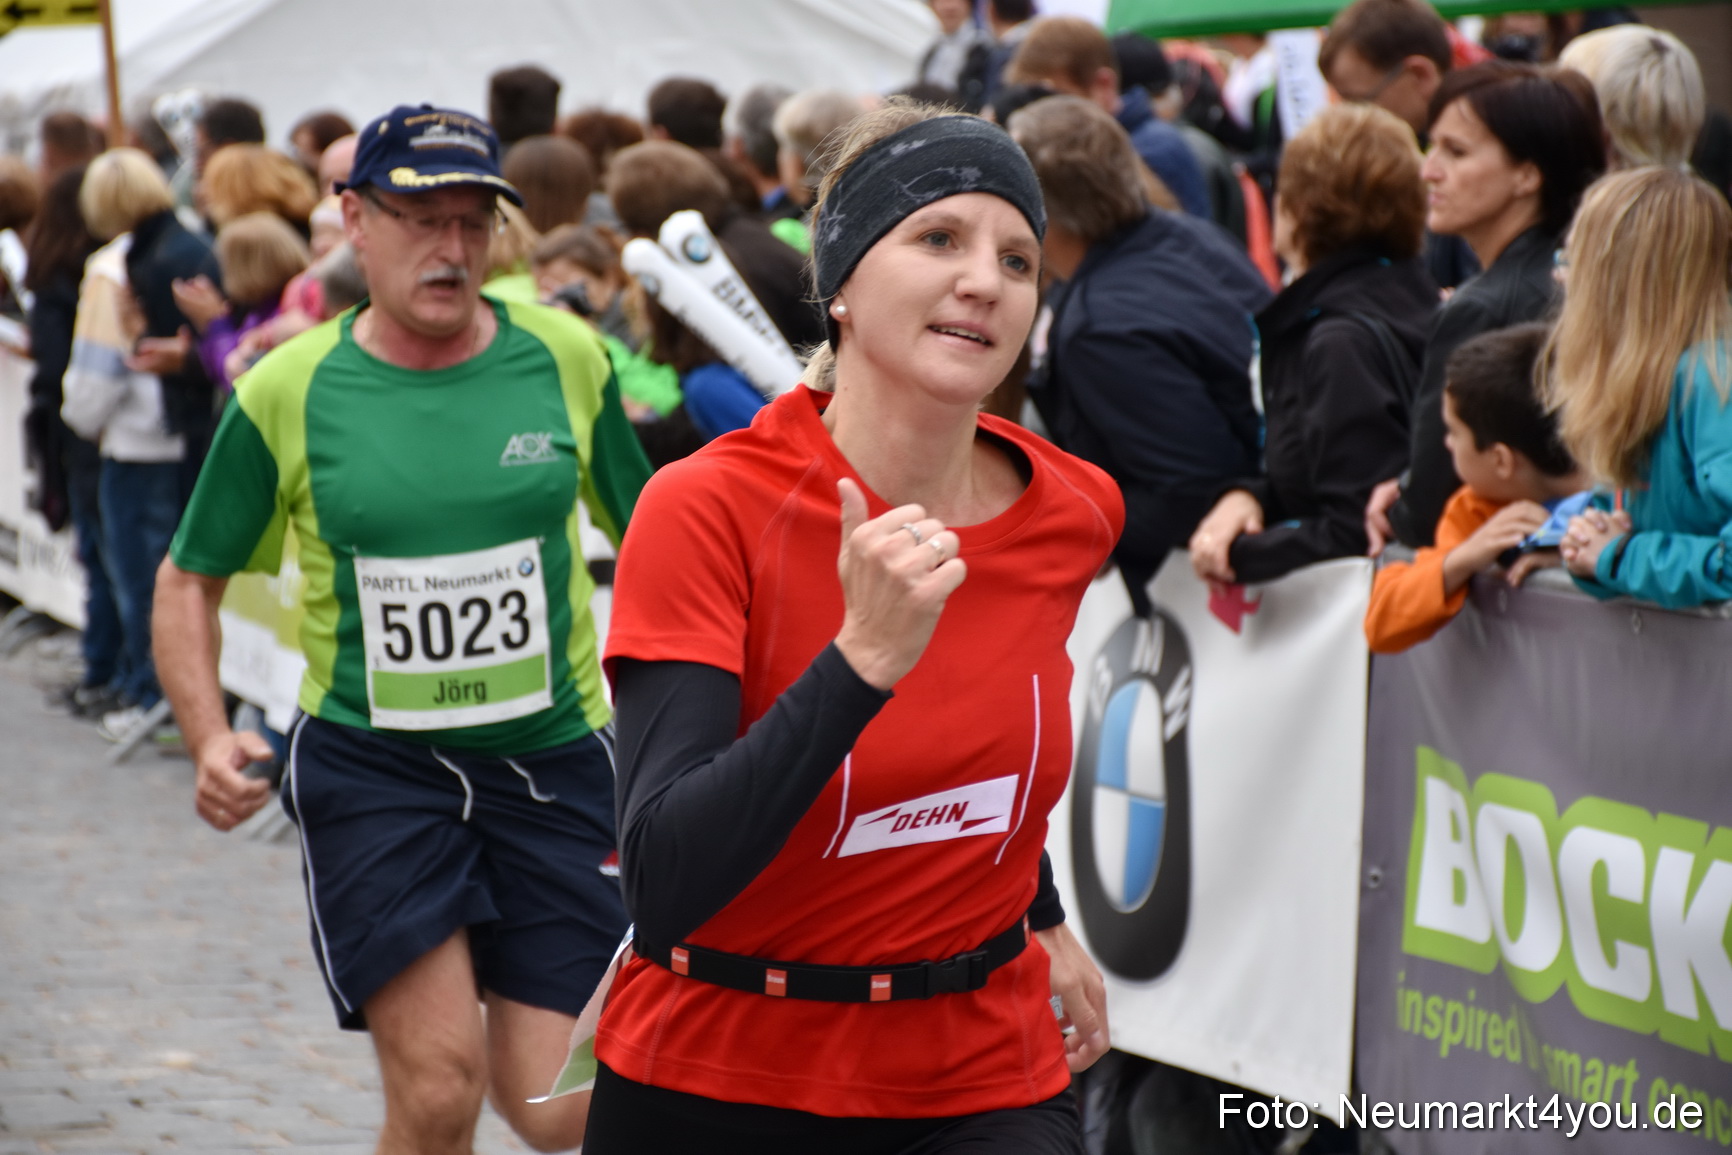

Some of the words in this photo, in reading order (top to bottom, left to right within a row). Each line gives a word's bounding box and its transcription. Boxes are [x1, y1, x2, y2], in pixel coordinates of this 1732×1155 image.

[499, 432, 559, 466] AOK
[362, 575, 419, 593] PARTL
[424, 567, 512, 591] Neumarkt
[381, 589, 531, 663] 5023
[433, 679, 488, 705] Jörg
[889, 801, 971, 834] DEHN
[1414, 775, 1732, 1033] BOCK
[1397, 969, 1522, 1064] inspired
